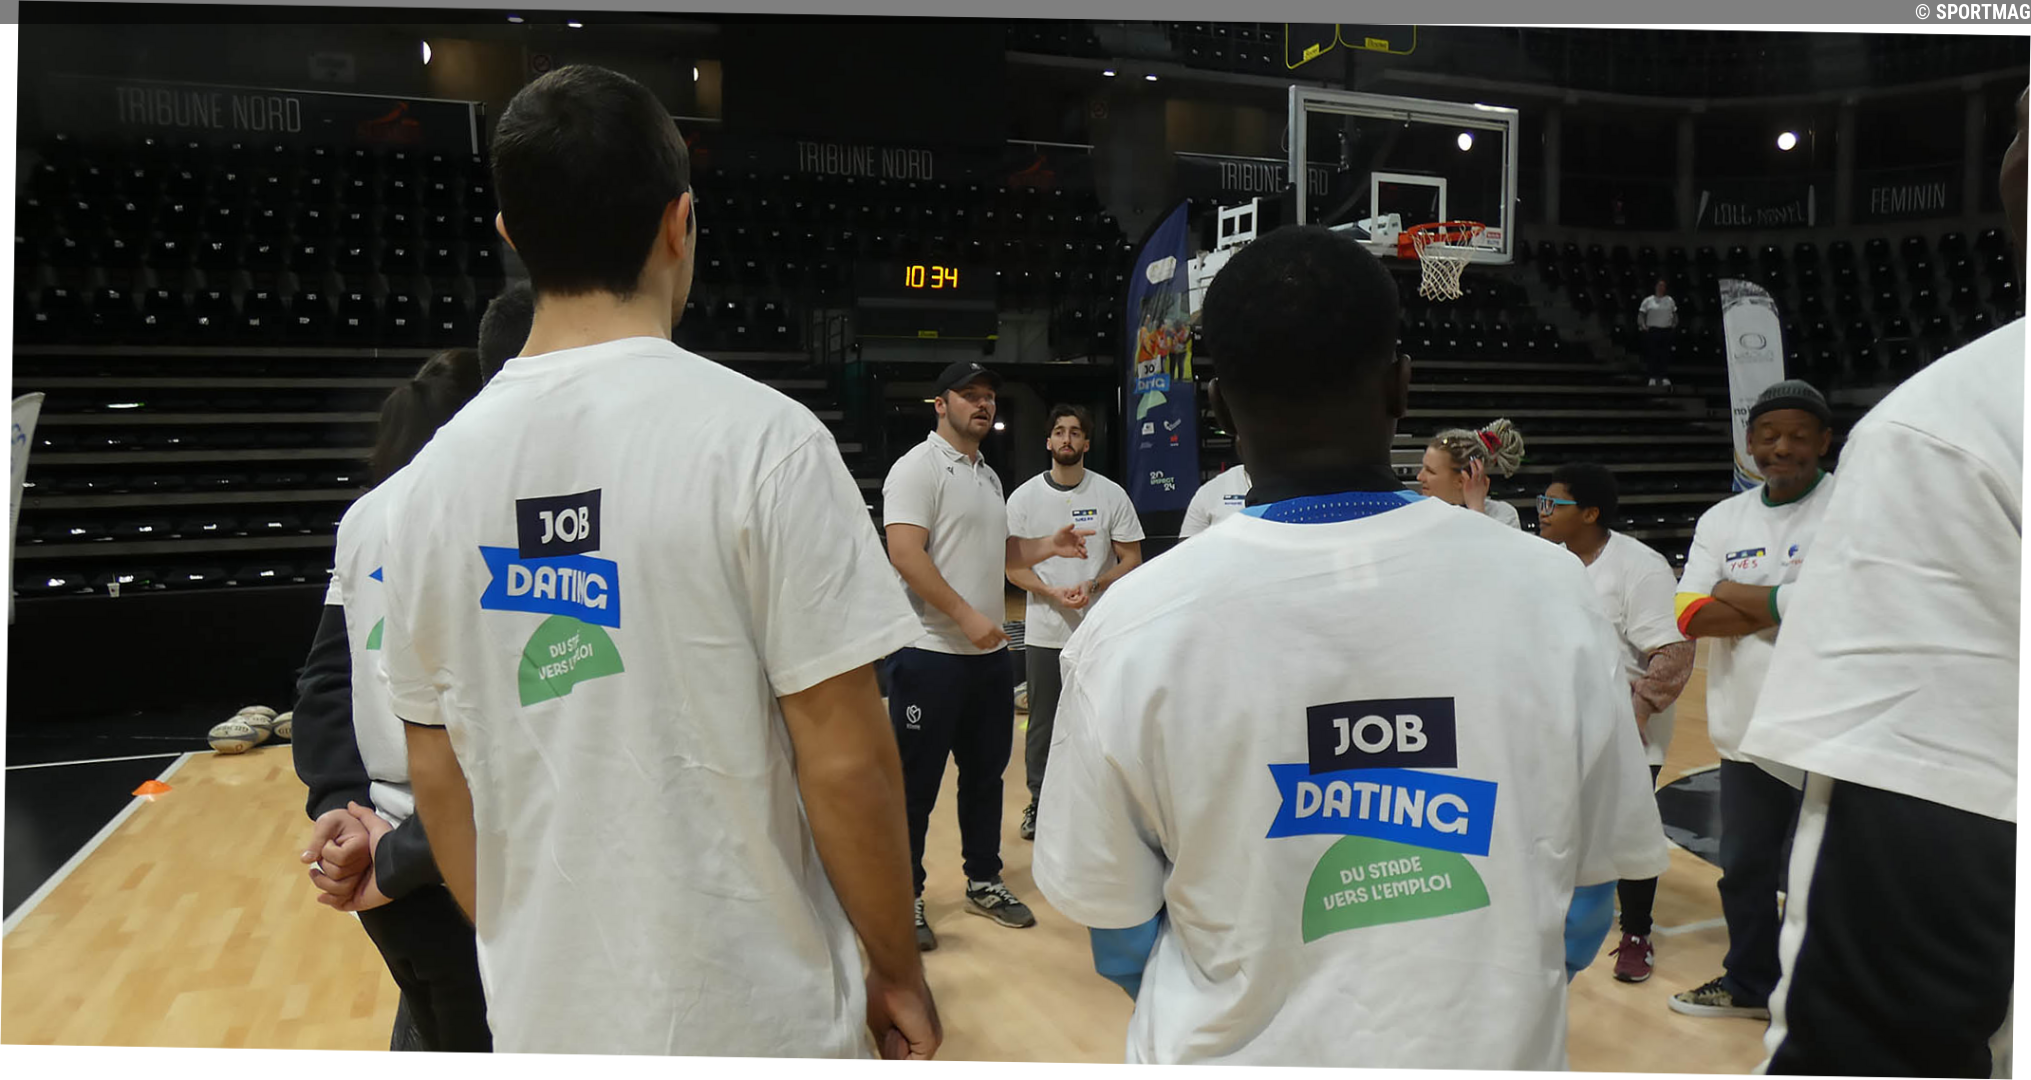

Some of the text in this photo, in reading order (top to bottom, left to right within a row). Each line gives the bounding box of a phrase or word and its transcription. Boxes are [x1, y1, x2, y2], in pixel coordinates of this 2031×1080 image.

[116, 86, 301, 133] TRIBUNE NORD
[797, 141, 933, 180] TRIBUNE NORD
[1219, 161, 1283, 193] TRIBUNE
[1871, 182, 1946, 214] FEMININ
[539, 506, 590, 544] JOB
[1731, 558, 1758, 572] YVES
[507, 564, 608, 610] DATING
[549, 641, 566, 658] DU
[539, 660, 569, 681] VERS
[1332, 714, 1428, 756] JOB
[1295, 780, 1469, 835] DATING
[1339, 855, 1423, 885] DU STADE
[1322, 872, 1453, 911] VERS L'EMPLOI
